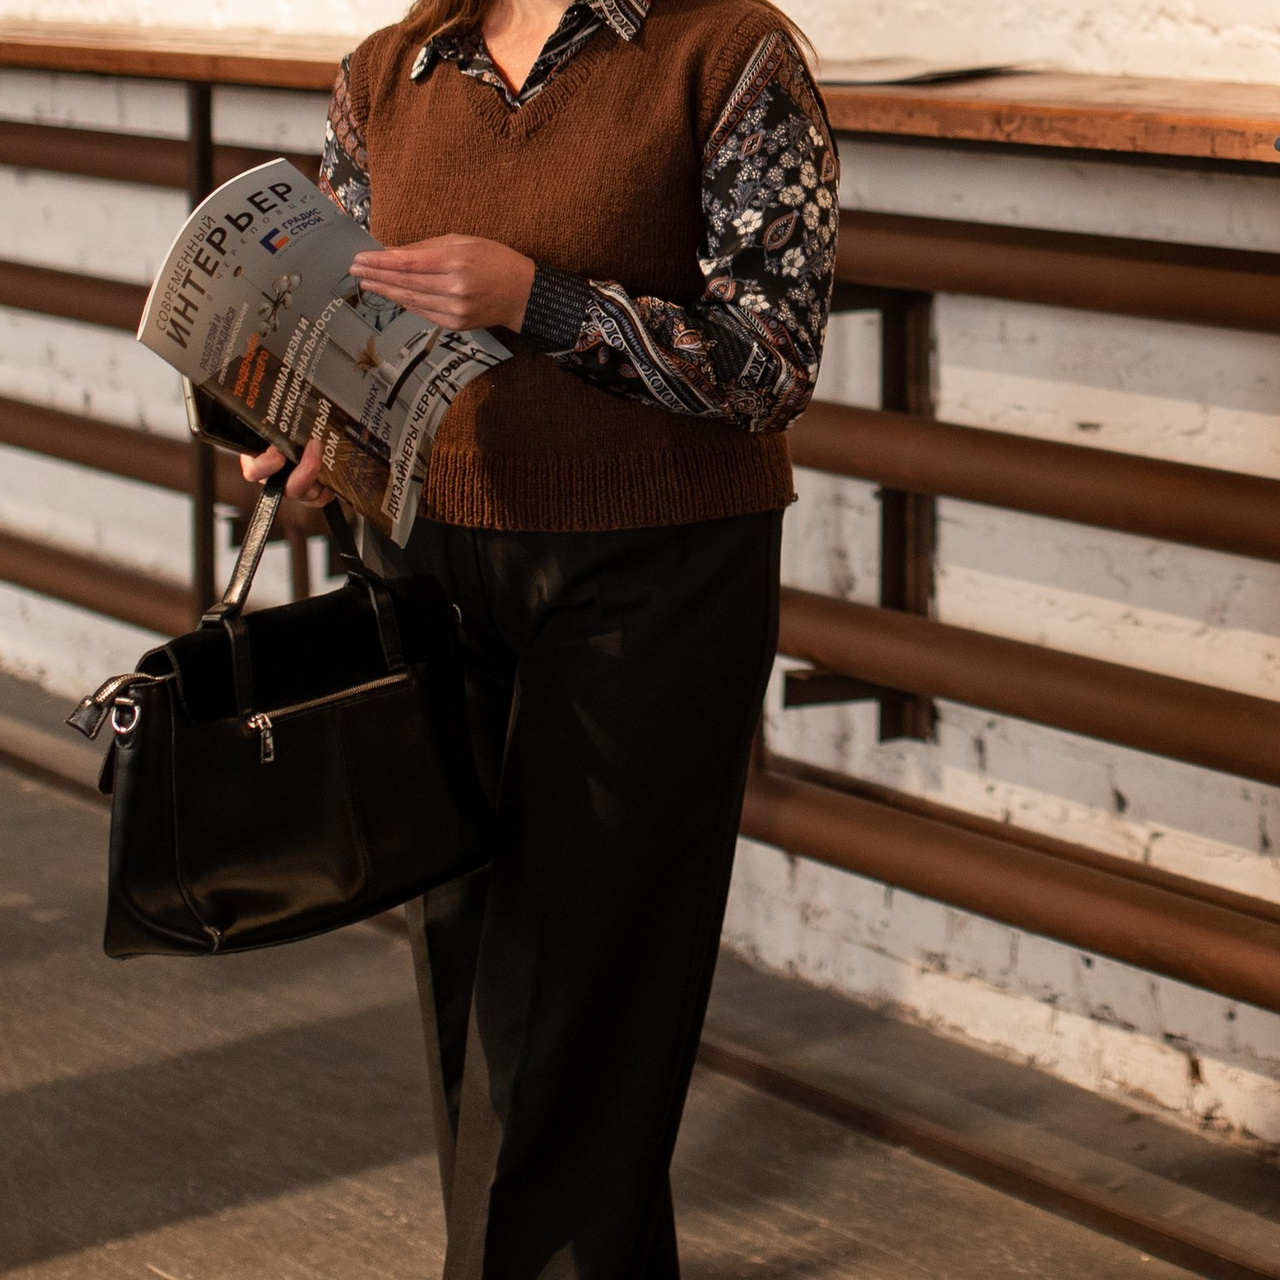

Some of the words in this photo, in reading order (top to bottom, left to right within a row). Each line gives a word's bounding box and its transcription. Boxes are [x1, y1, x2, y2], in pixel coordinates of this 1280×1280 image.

[281, 207, 321, 230] ГРАДИС
[290, 215, 324, 235] СТРОЙ
[156, 215, 216, 331] СОВРЕМЕННЫЙ
[166, 182, 293, 350] ИНТЕРЬЕР
[200, 321, 220, 372] РАЗДЕЛЯЙ
[214, 312, 224, 324] И
[233, 332, 259, 397] ТЕНДЕНЦИИ
[266, 329, 304, 424] МИНИМАЛИЗМ
[299, 316, 310, 330] И
[279, 297, 344, 433] ФУНКЦИОНАЛЬНОСТЬ
[246, 349, 269, 409] БУДУЩЕГО
[311, 397, 332, 440] НЫЙ
[387, 424, 420, 520] ДИЗАЙНЕРЫ
[413, 347, 480, 423] ЧЕРЕПОВЦА
[322, 431, 340, 472] ДОМ
